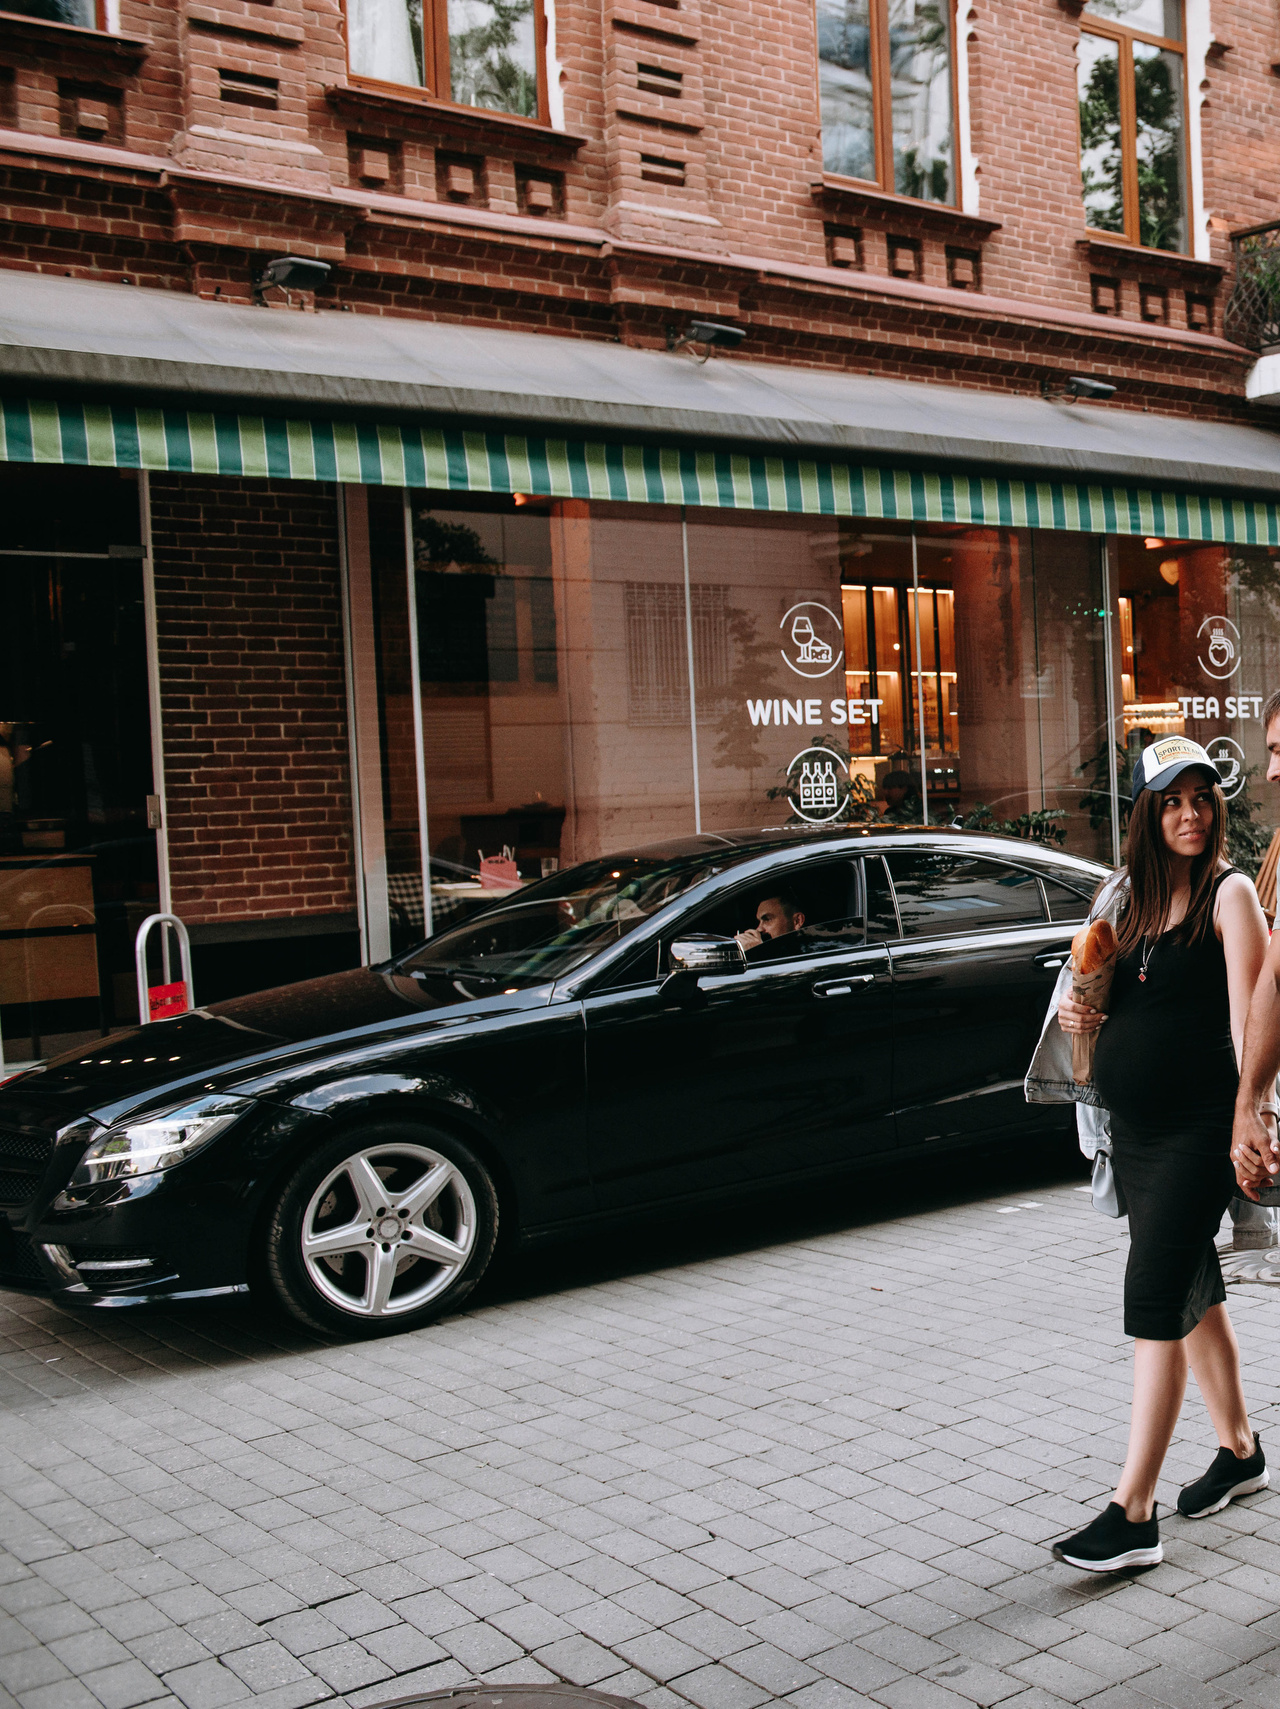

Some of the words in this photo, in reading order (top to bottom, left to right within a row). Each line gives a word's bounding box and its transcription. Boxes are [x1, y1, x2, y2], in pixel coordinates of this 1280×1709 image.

[747, 699, 823, 726] WINE
[830, 699, 884, 725] SET
[1178, 696, 1220, 719] TEA
[1225, 696, 1263, 719] SET
[1158, 745, 1182, 758] SPORT
